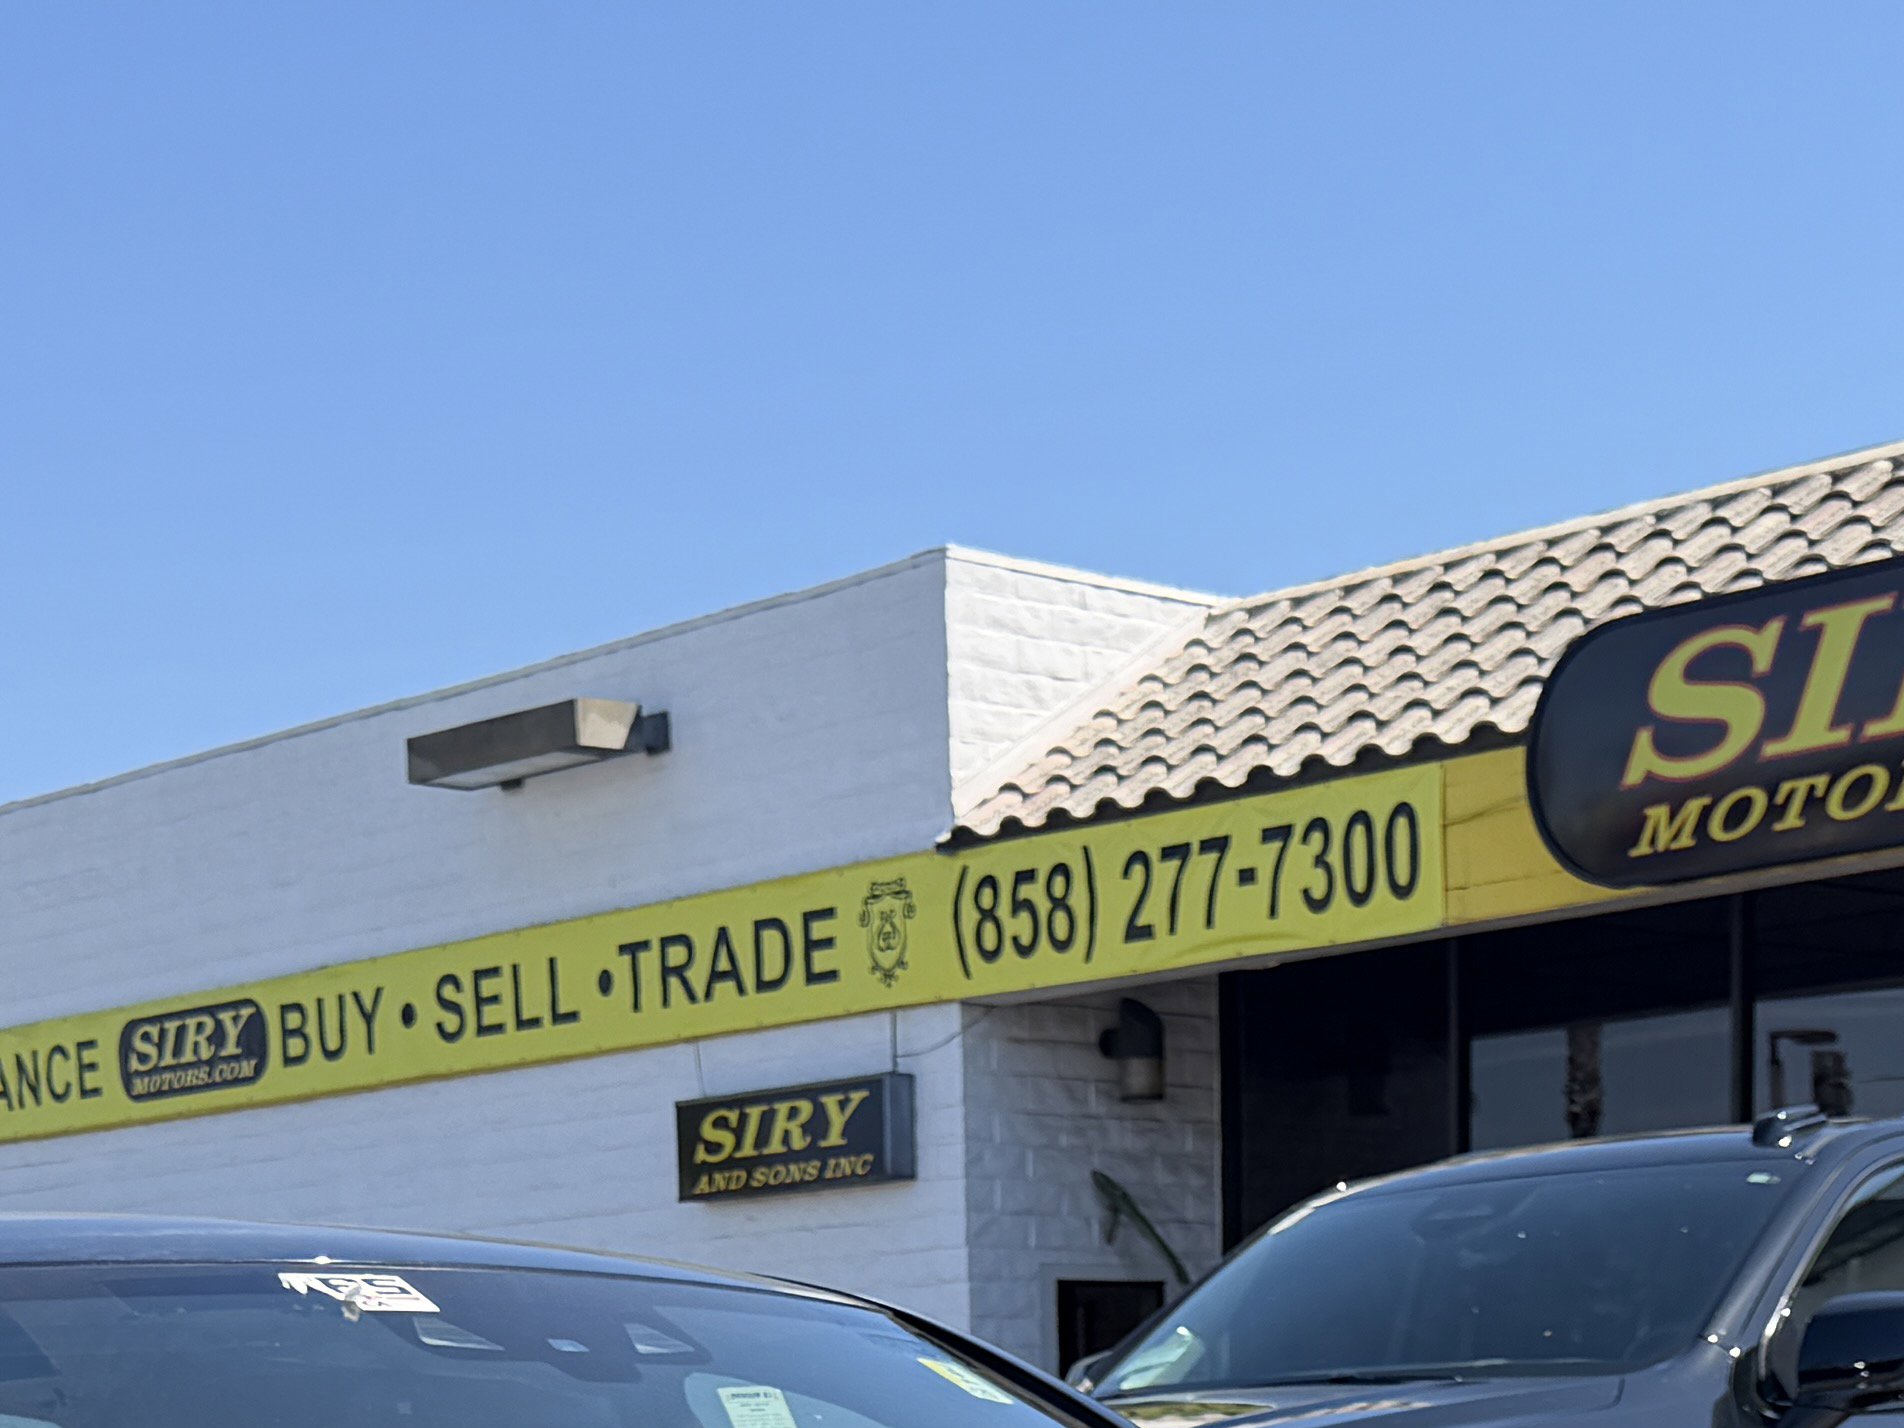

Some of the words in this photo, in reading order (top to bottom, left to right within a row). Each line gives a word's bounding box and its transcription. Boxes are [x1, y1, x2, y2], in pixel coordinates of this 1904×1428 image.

[952, 845, 1099, 980] (858)
[1122, 800, 1420, 944] 277-7300
[279, 986, 385, 1066] BUY
[436, 955, 580, 1043] SELL
[618, 907, 842, 1013] TRADE
[129, 1007, 257, 1074] SIRY
[131, 1059, 258, 1096] MOTORS.COM
[692, 1089, 871, 1165] SIRY
[692, 1169, 748, 1196] AND
[749, 1158, 822, 1188] SONS
[824, 1152, 875, 1180] INC
